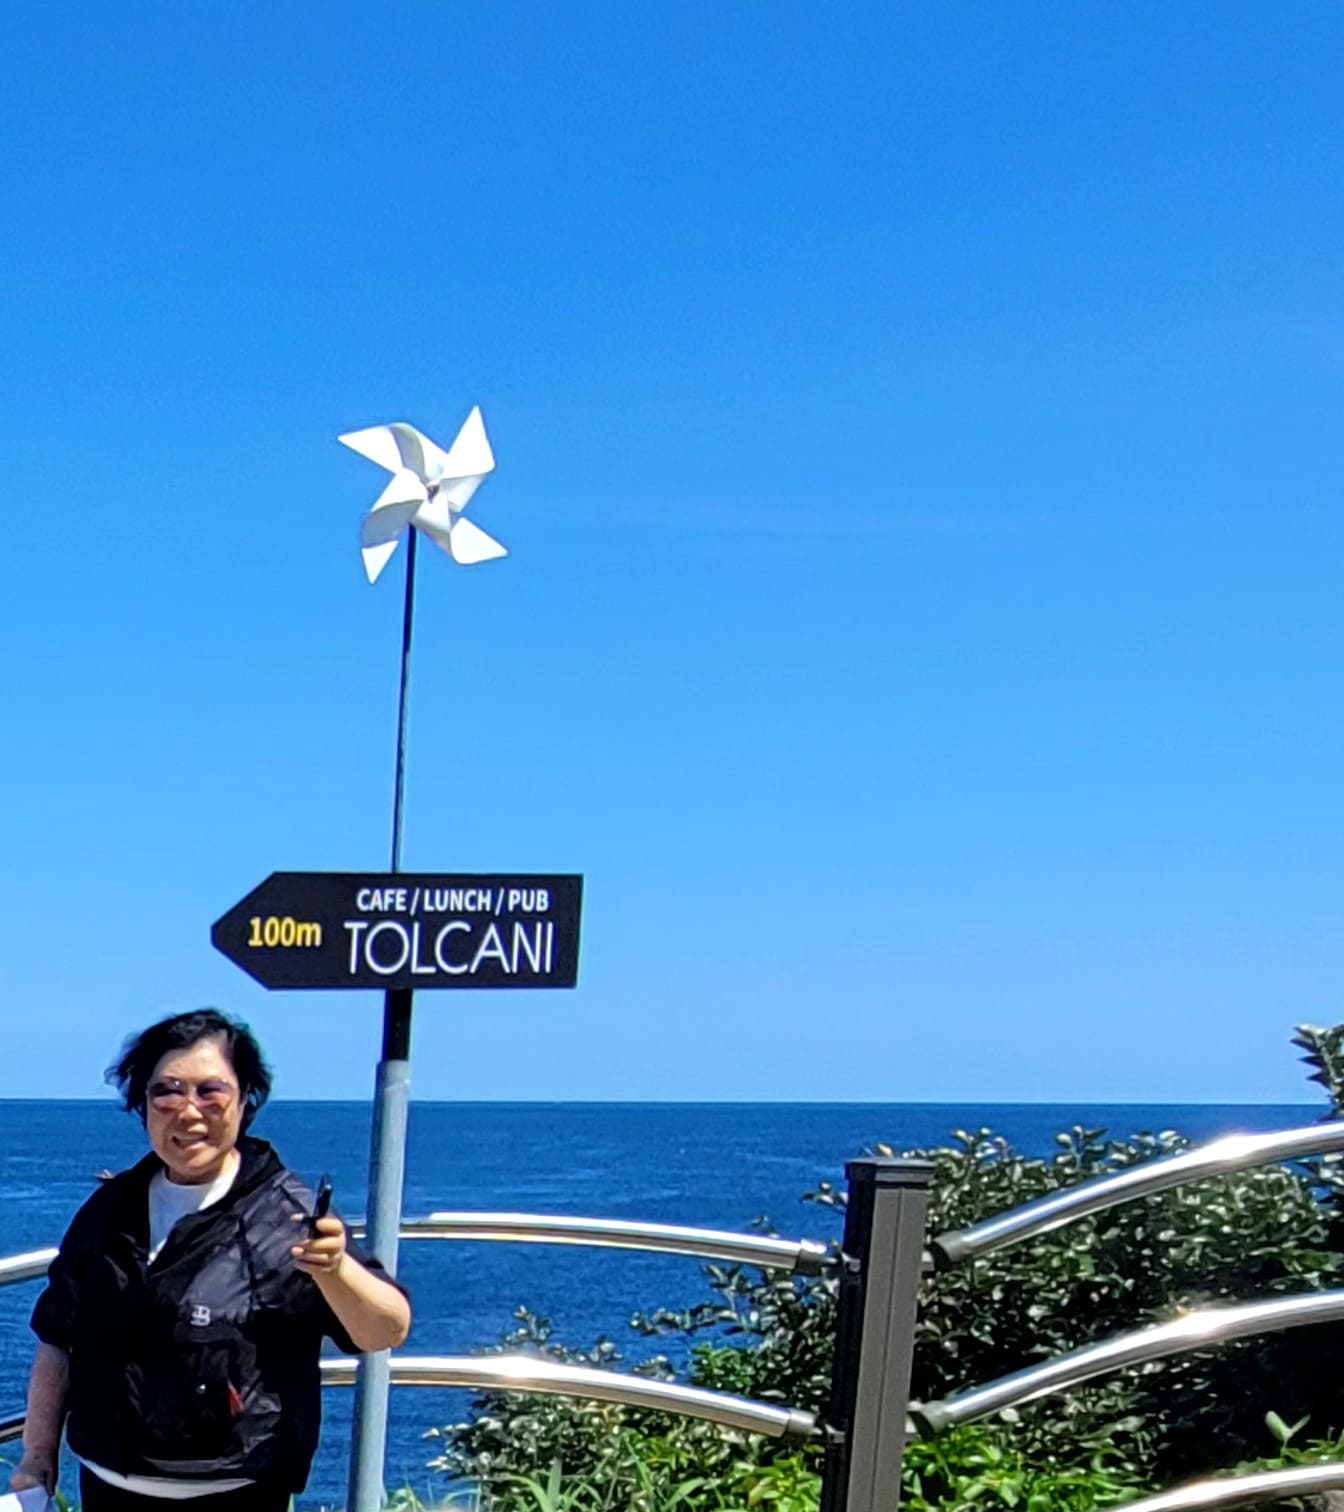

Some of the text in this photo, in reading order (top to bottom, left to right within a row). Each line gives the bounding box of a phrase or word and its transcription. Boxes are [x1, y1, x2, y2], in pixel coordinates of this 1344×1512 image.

[356, 888, 407, 912] CAFE
[423, 888, 492, 912] LUNCH
[508, 888, 549, 912] PUB
[247, 916, 322, 949] 100m
[343, 921, 554, 975] TOLCANI
